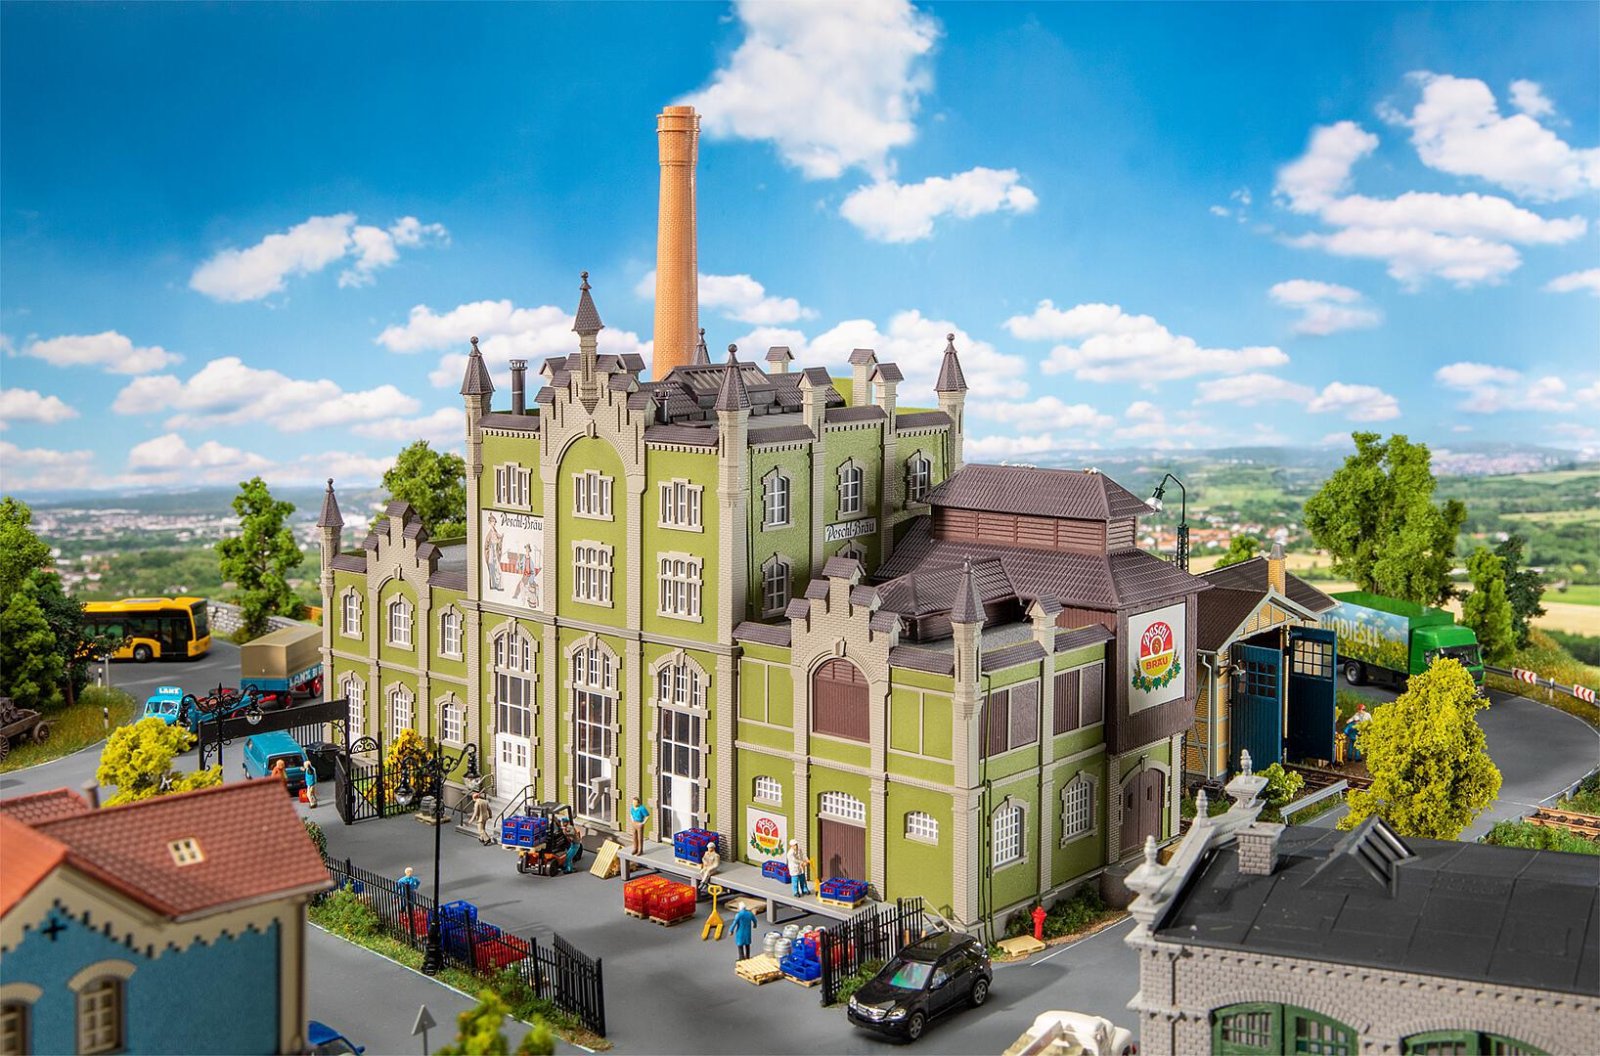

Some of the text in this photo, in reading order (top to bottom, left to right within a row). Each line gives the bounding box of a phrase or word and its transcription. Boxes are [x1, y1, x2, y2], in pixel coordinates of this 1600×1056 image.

[500, 512, 543, 531] Peschl-Bräu
[826, 520, 875, 541] Peschl-Bräu
[1143, 624, 1170, 647] Peschl
[1320, 613, 1380, 648] BIODIESEL
[1146, 656, 1168, 670] BRÄU
